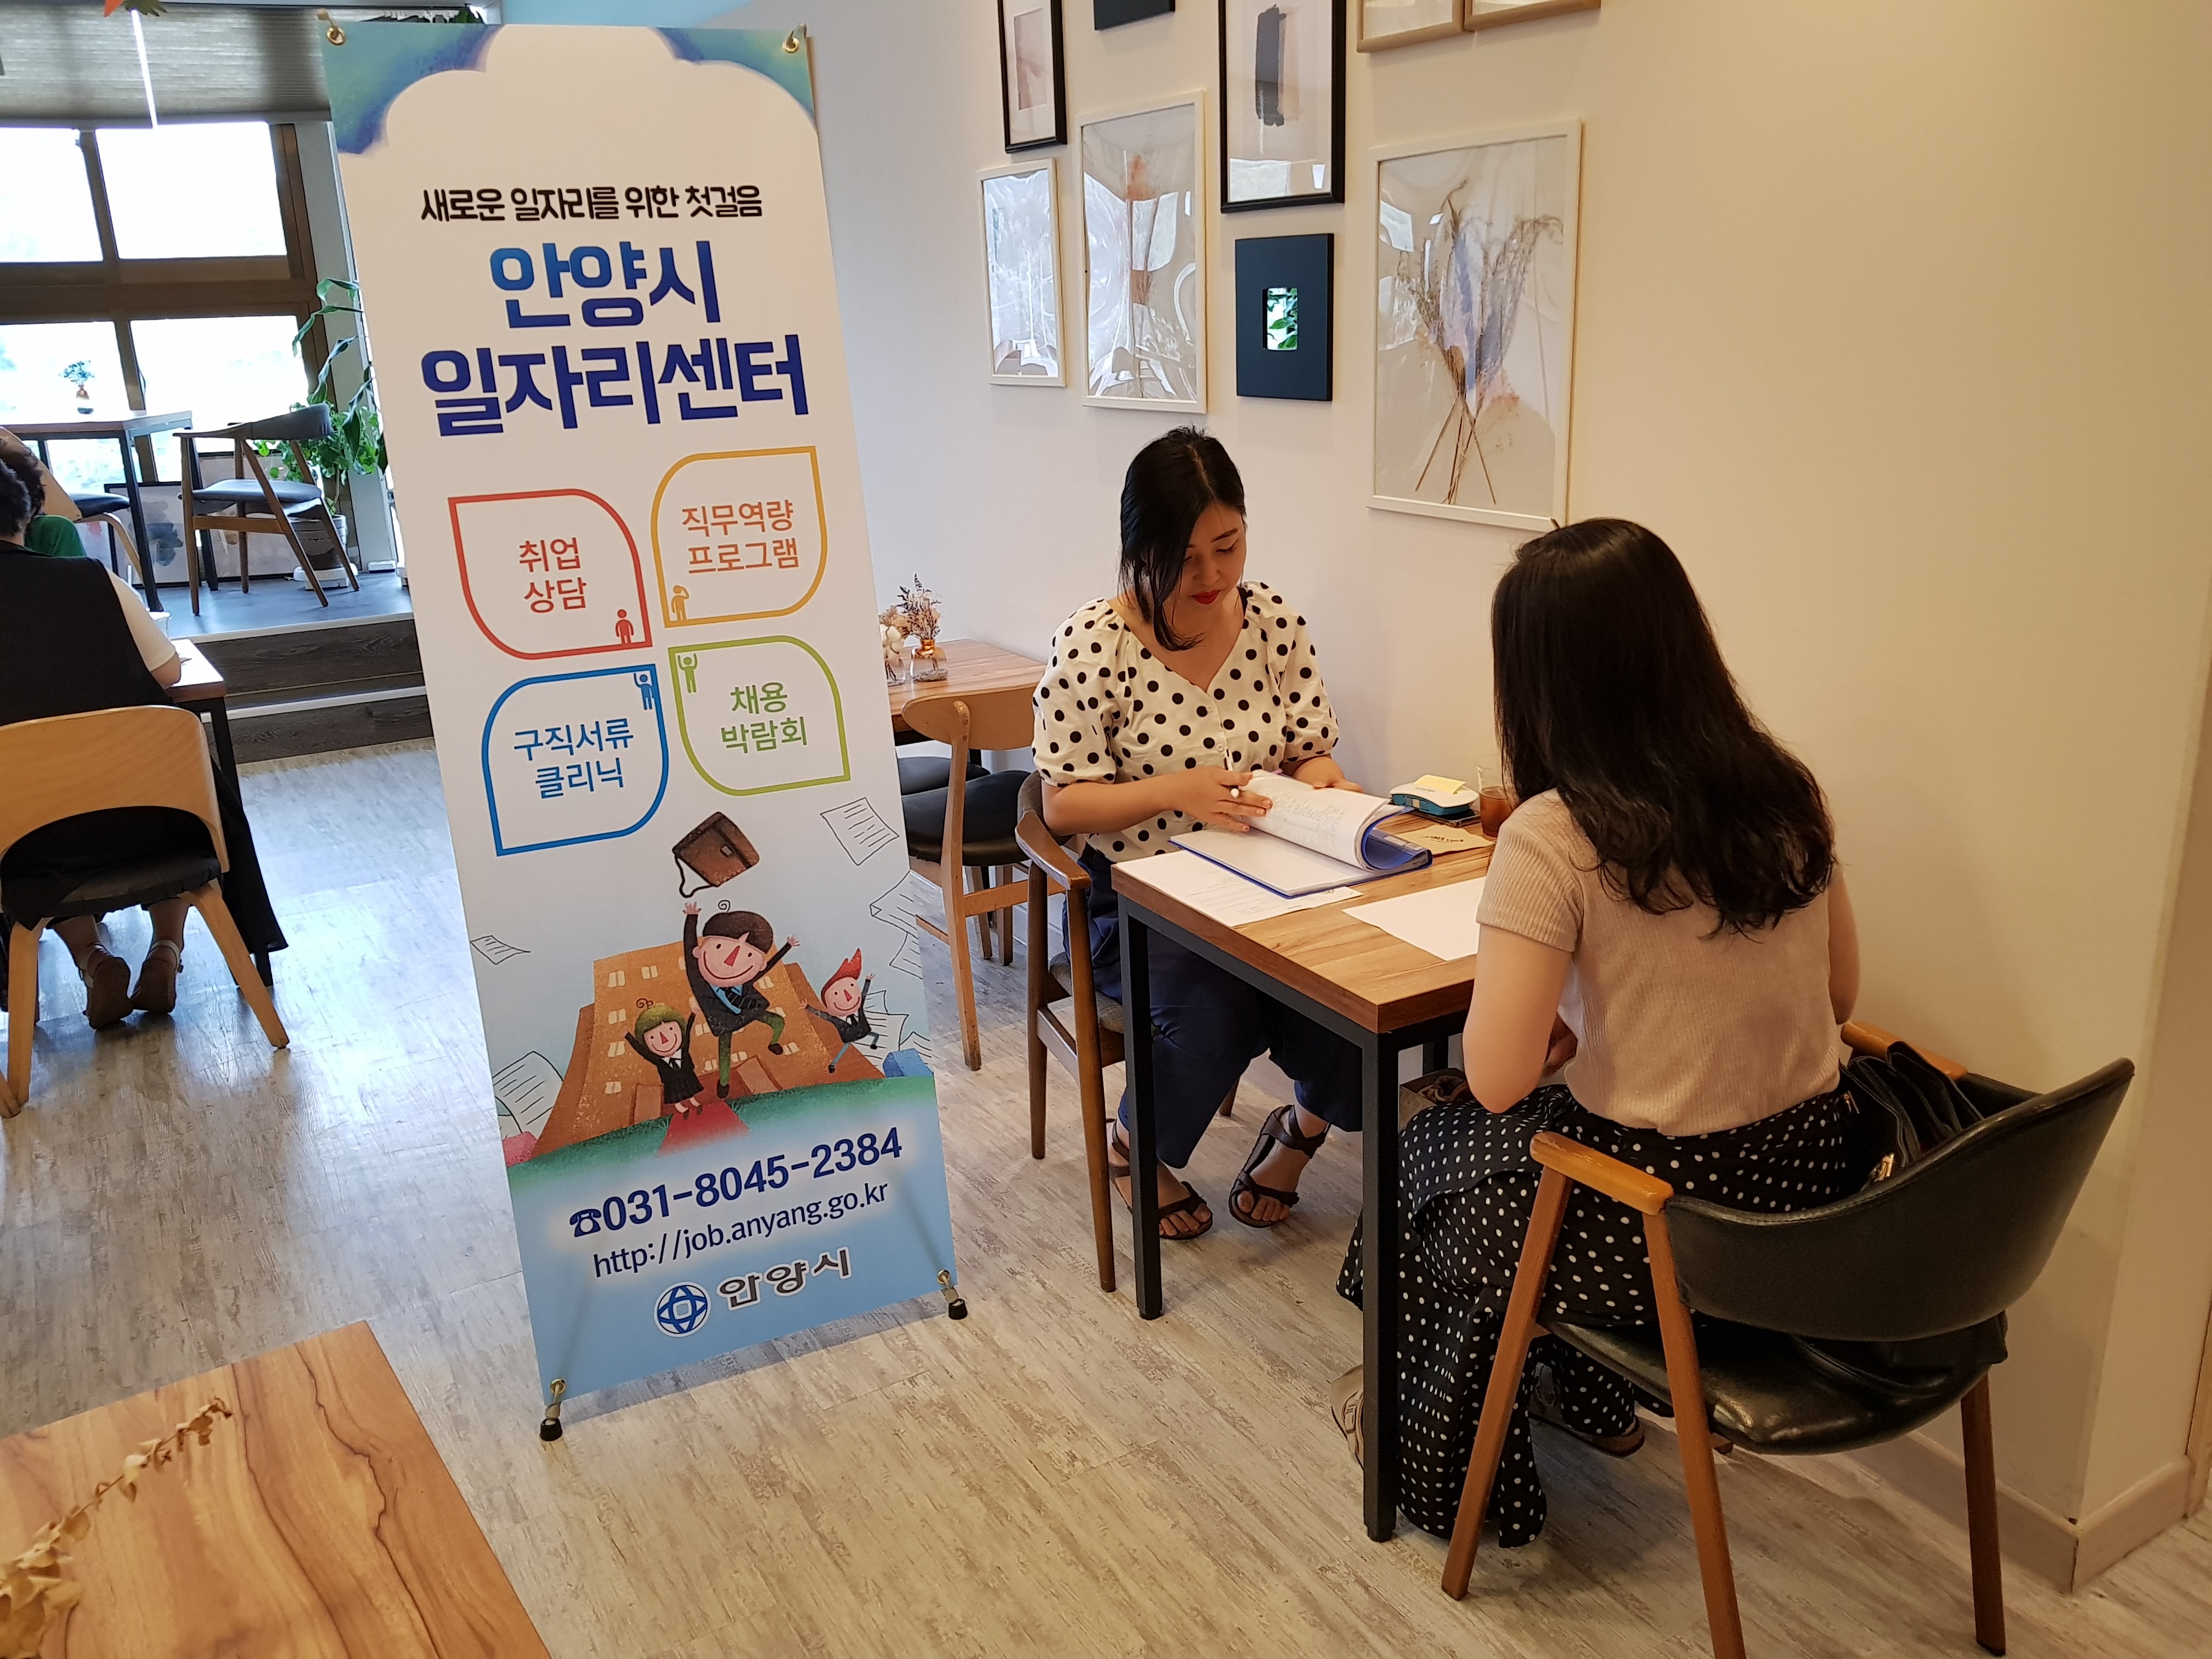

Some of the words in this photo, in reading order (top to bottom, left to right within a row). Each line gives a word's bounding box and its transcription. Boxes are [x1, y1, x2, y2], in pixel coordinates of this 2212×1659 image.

[421, 188, 505, 222] 새로운
[510, 186, 619, 221] 일자리를
[624, 184, 680, 219] 위한
[685, 185, 763, 218] 첫걸음
[489, 240, 721, 329] 안양시
[421, 334, 809, 437] 일자리센터
[681, 499, 795, 538] 직무역량
[519, 537, 581, 573] 취업
[688, 537, 799, 574] 프로그램
[523, 577, 587, 613] 상담
[730, 682, 788, 714] 채용
[514, 718, 634, 761] 구직서류
[721, 716, 808, 754] 박람회
[535, 758, 624, 799] 클리닉
[602, 1126, 902, 1231] 031-8045-2384
[593, 1180, 889, 1278] http://job.anyang.go.kr
[718, 1248, 851, 1310] 안양시
